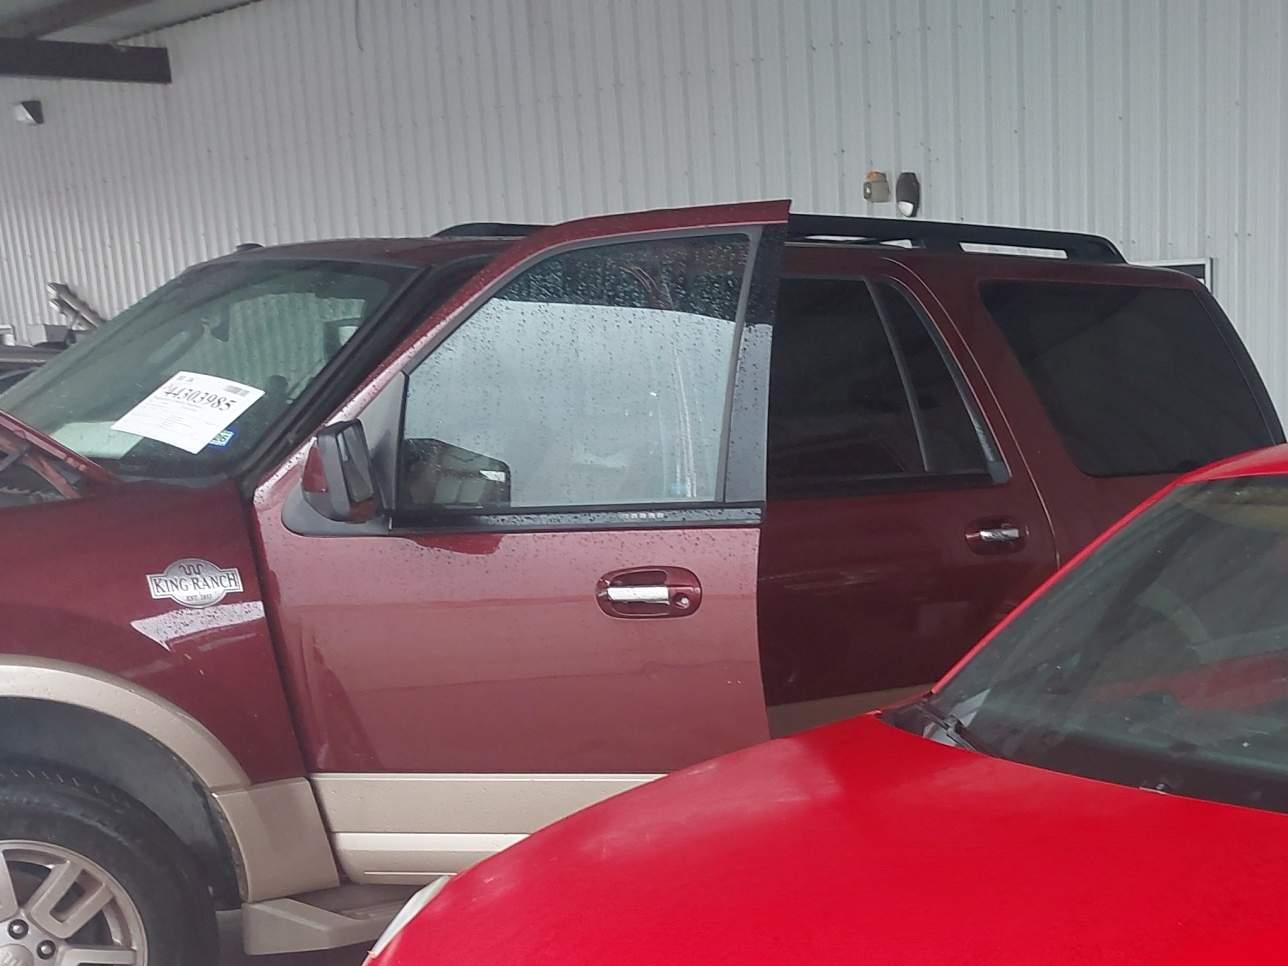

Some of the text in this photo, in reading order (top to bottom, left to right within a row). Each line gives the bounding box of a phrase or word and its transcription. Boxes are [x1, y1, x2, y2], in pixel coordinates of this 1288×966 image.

[165, 386, 237, 411] 44303985
[153, 572, 239, 594] KING RANCH
